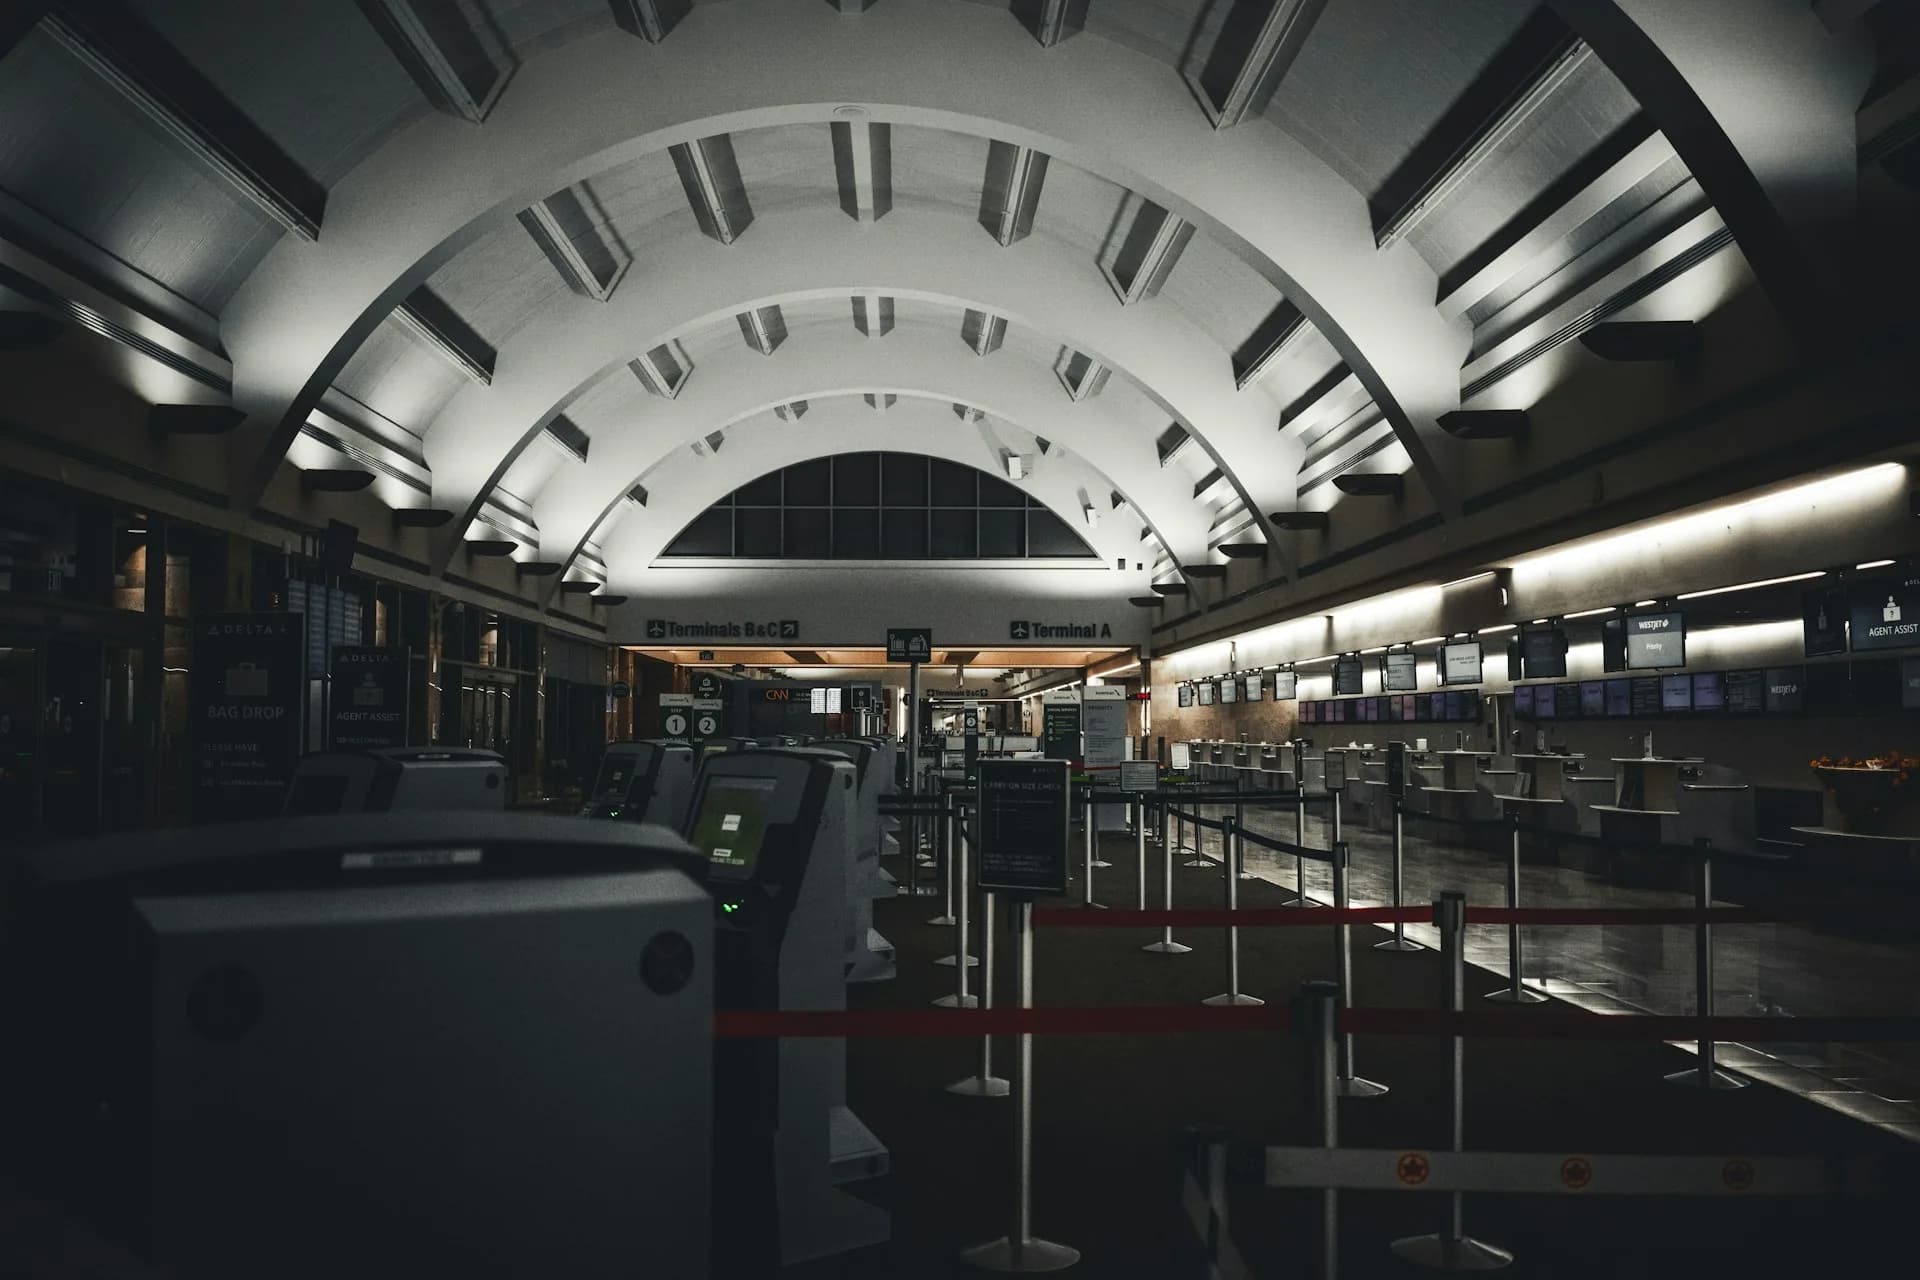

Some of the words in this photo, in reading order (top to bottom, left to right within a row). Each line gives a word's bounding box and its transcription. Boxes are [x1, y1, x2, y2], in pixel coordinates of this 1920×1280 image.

[223, 624, 273, 635] DELTA
[667, 621, 741, 638] Terminals
[745, 622, 777, 638] B&C
[1032, 622, 1096, 639] Terminal
[1100, 623, 1111, 639] A
[1638, 619, 1663, 631] WESTJET
[1868, 626, 1893, 637] AGENT
[1894, 623, 1919, 635] ASSIST
[351, 653, 390, 663] DELTA
[766, 688, 789, 701] CNN
[1770, 684, 1792, 696] WESTJET
[207, 705, 239, 720] BAG
[242, 705, 285, 720] DROP
[336, 711, 368, 721] AGENT
[369, 711, 401, 721] ASSIST
[703, 719, 711, 731] 2
